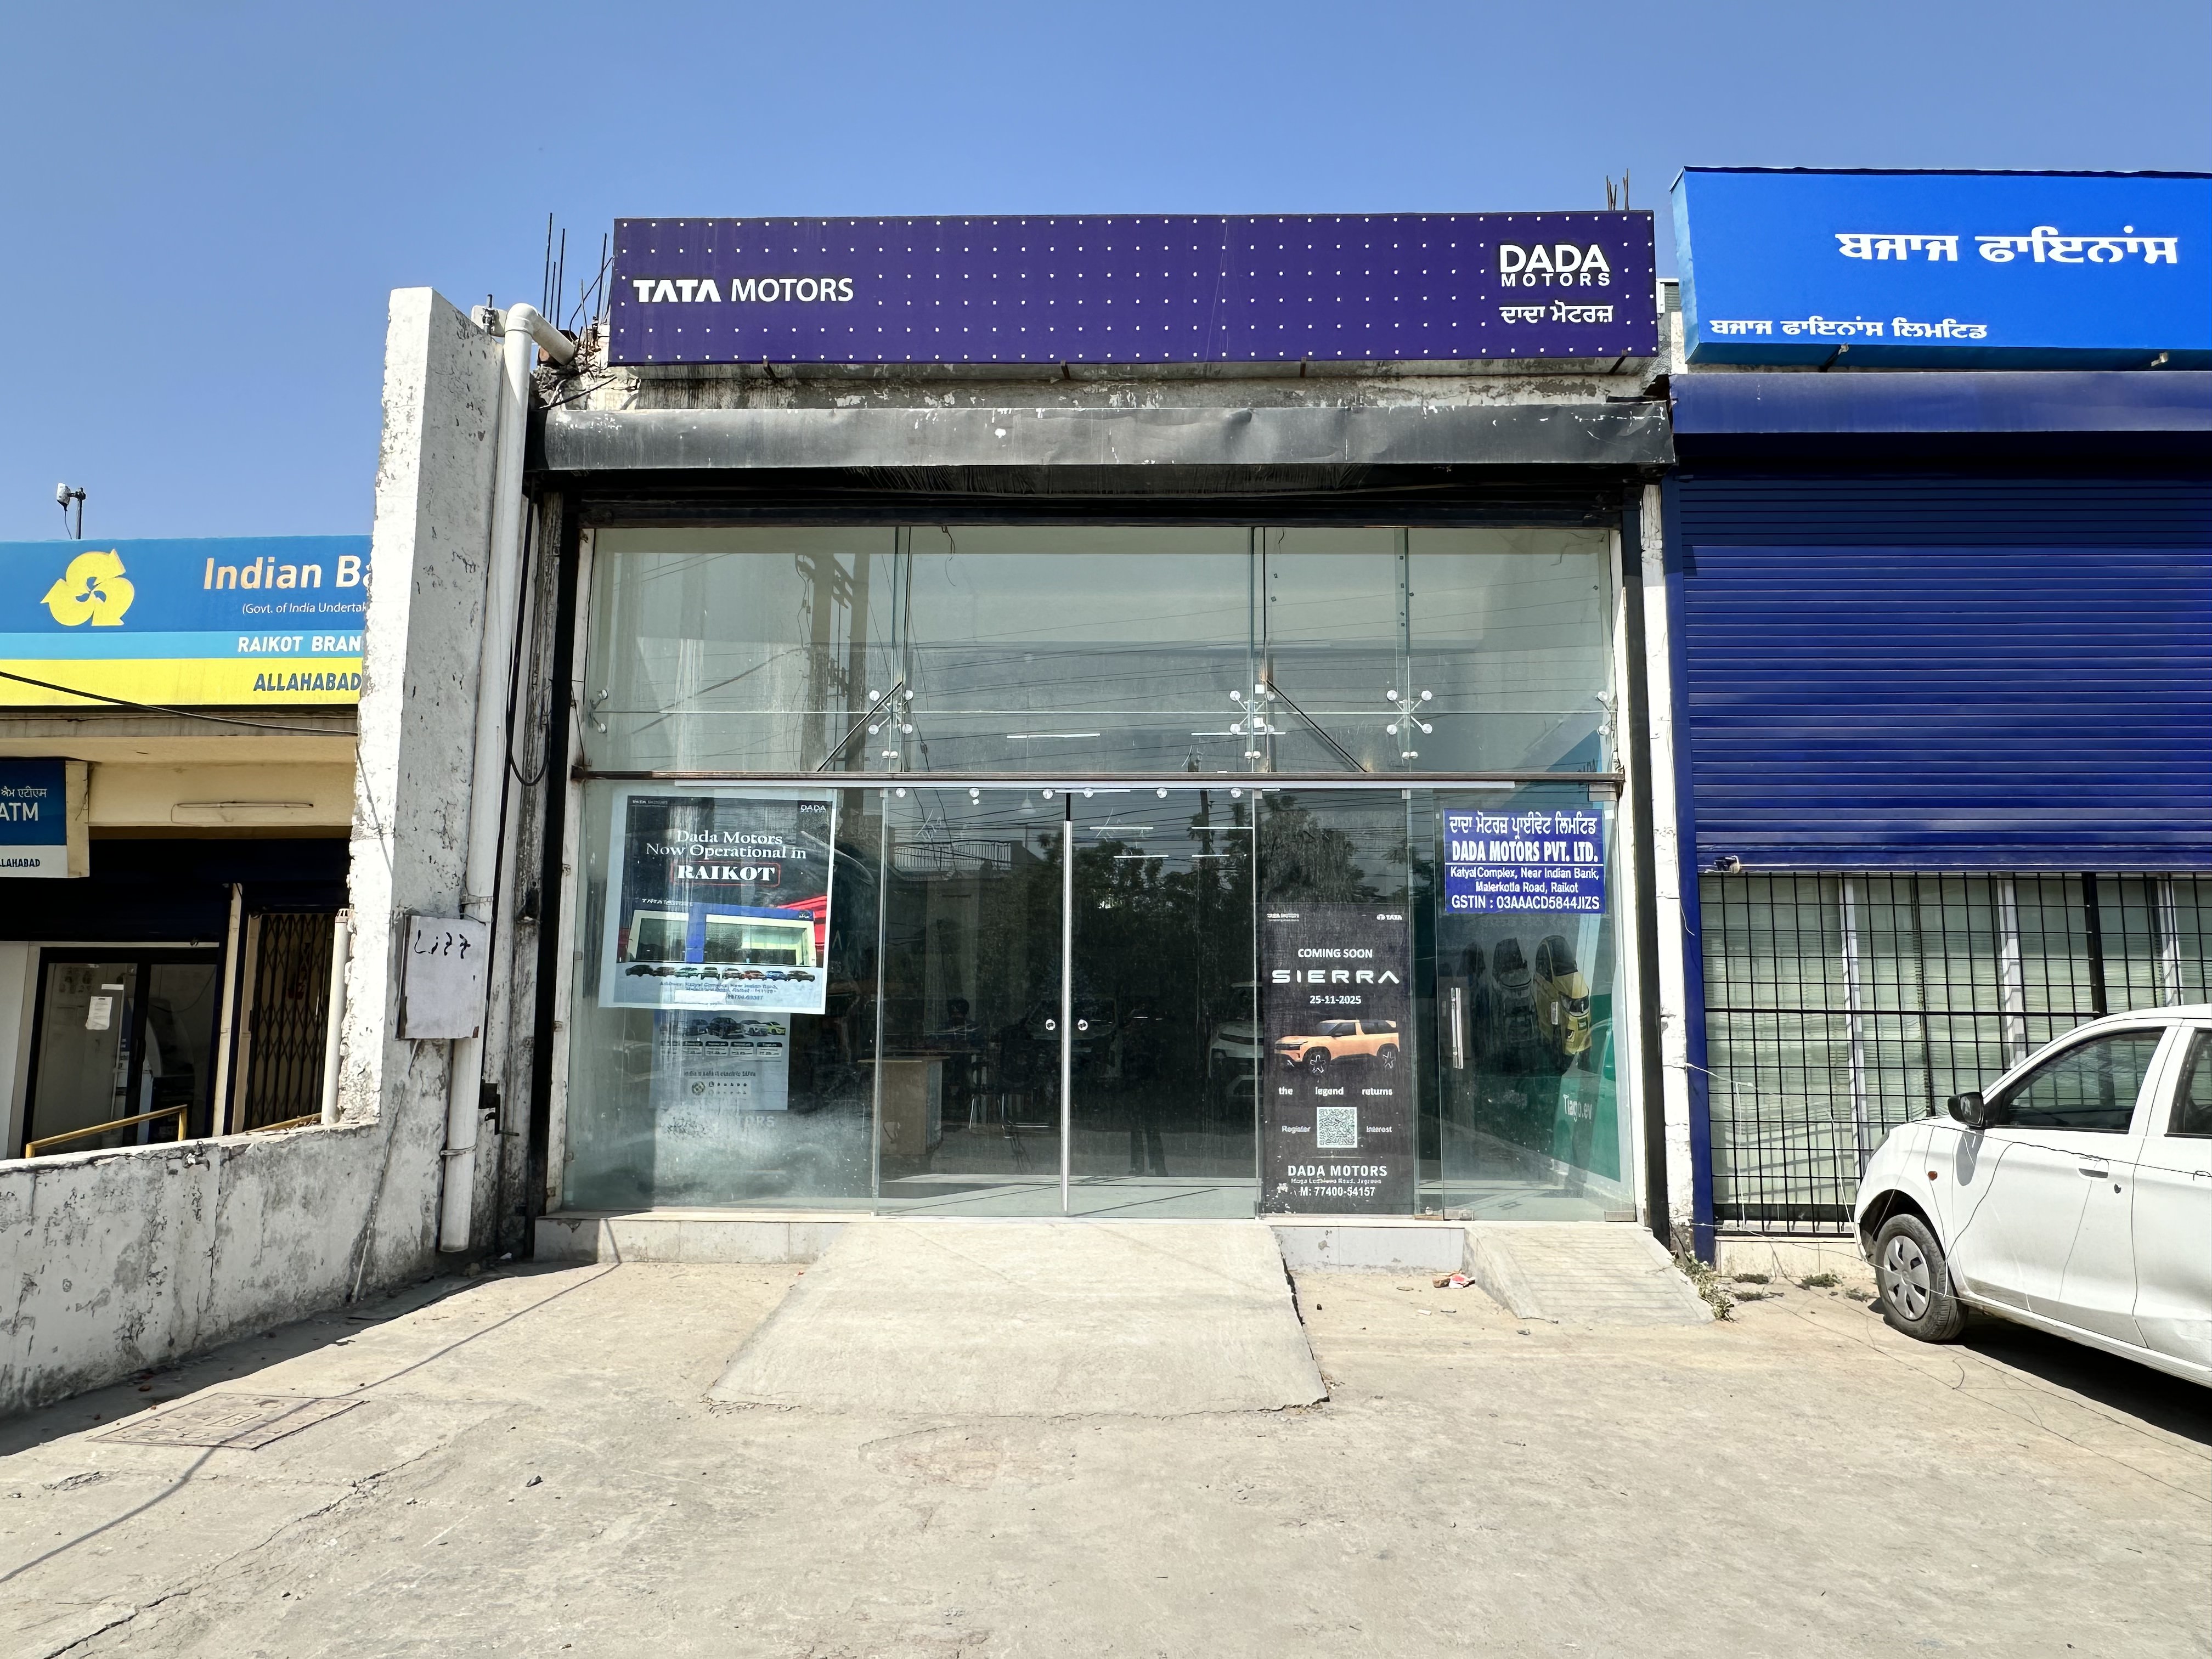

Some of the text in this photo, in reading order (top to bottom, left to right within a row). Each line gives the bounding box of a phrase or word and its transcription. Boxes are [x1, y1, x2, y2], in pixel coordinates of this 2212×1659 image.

[1835, 225, 2179, 264] ਬਜਾਜ ਫਾਇਨਾਂਸ
[1500, 244, 1610, 273] DADA
[1501, 273, 1610, 287] MOTORS
[633, 278, 854, 302] TATA MOTORS
[1499, 306, 1545, 324] ਦਾਦਾ
[1709, 316, 1988, 338] ਬਜਾਜ ਫਾਇਨਾਂਸ ਲਿਮਟਿਡ
[204, 556, 322, 590] Indian
[242, 603, 273, 614] (Govt.
[276, 603, 287, 613] of
[289, 603, 315, 613] India
[238, 637, 303, 652] RAIKOT
[253, 673, 362, 691] ALLAHABAD
[0, 802, 38, 821] ATM
[1449, 816, 1472, 833] ਦਾਦਾ
[677, 830, 782, 844] Dada Motors
[646, 843, 806, 860] Now Operational in
[1452, 841, 1599, 862] DADA MOTORS PVT. LTD.
[0, 858, 41, 867] LAHABAD
[678, 865, 775, 881] RAIKOT
[1451, 866, 1599, 880] Katyal Complex, Near Indian Bank,
[1523, 882, 1548, 893] Road,
[1551, 883, 1578, 893] Raikot
[1452, 895, 1486, 909] GSTIN
[1298, 949, 1373, 958] COMING SOON
[1272, 969, 1400, 984] SIERRA
[1310, 995, 1362, 1004] 25-11-2025
[1279, 1086, 1293, 1095] the
[1315, 1087, 1344, 1097] legend
[1563, 1094, 1592, 1122] Tiago.ev
[1288, 1165, 1387, 1177] DADA MOTORS
[1314, 1187, 1376, 1197] 77400-54157
